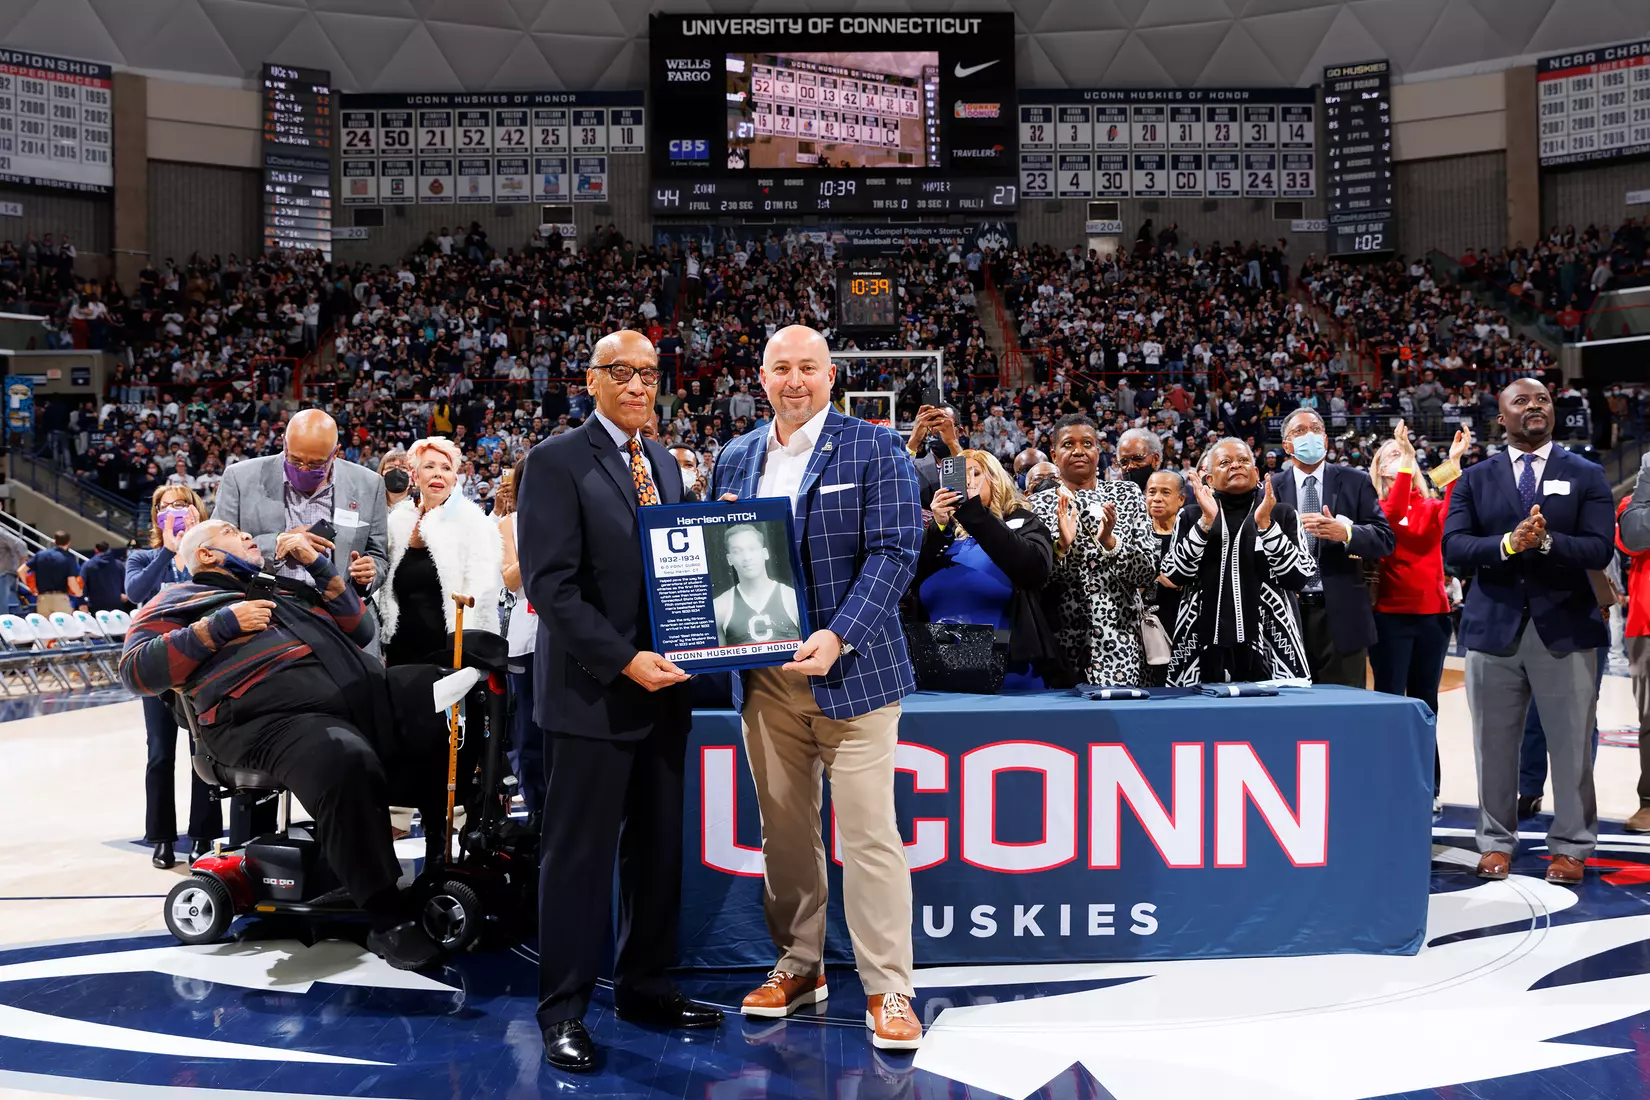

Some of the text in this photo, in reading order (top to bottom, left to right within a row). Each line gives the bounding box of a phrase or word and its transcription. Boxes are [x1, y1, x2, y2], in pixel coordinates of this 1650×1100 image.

[682, 17, 982, 35] UNIVERSITY OF CONNECTICUT
[665, 58, 712, 70] WELLS
[1550, 52, 1597, 70] NCAA
[667, 70, 712, 82] FARGO
[1326, 62, 1388, 78] GO HUSKIES
[754, 80, 770, 93] 52
[406, 93, 578, 105] UCONN HUSKIES OF HONOR
[800, 85, 857, 105] 00 13 42
[1083, 91, 1251, 100] UCONN HUSKIES OF HONOR
[738, 122, 753, 139] 27
[758, 114, 766, 128] 15
[780, 117, 791, 130] 22
[845, 125, 856, 138] 13
[885, 130, 896, 144] C
[1029, 124, 1305, 142] 32 3 20 31 23 31 14
[346, 126, 634, 148] 24 50 21 52 42 25 33 10
[669, 139, 706, 152] CBS
[952, 148, 997, 159] TRAVELERS
[757, 178, 805, 188] POSS BONUS
[896, 177, 913, 186] POSS
[1026, 172, 1311, 190] 23 4 30 3 CD 15 24 33
[819, 180, 857, 197] 10:39
[993, 185, 1017, 205] 27
[656, 189, 681, 207] 44
[885, 199, 898, 208] FLS
[928, 199, 942, 208] SEC
[959, 199, 977, 208] FULL
[693, 202, 711, 210] FULL
[720, 200, 728, 210] 2
[739, 201, 755, 210] SEC
[785, 201, 799, 210] FLS
[843, 227, 864, 238] Harry
[865, 227, 873, 236] A.
[874, 227, 902, 238] Gampel
[903, 226, 932, 236] Pavilion
[963, 226, 975, 236] CT
[1100, 223, 1122, 231] 204
[852, 237, 890, 246] Basketball
[1355, 233, 1383, 250] 1:02
[850, 278, 889, 296] 10:39
[1565, 414, 1585, 427] 05
[677, 511, 758, 527] Harrison FITCH
[667, 528, 690, 553] C
[659, 554, 700, 563] 1932-1934
[748, 614, 774, 642] C
[669, 642, 800, 662] UCONN HUSKIES OF HONOR
[922, 901, 1160, 940] USKIES
